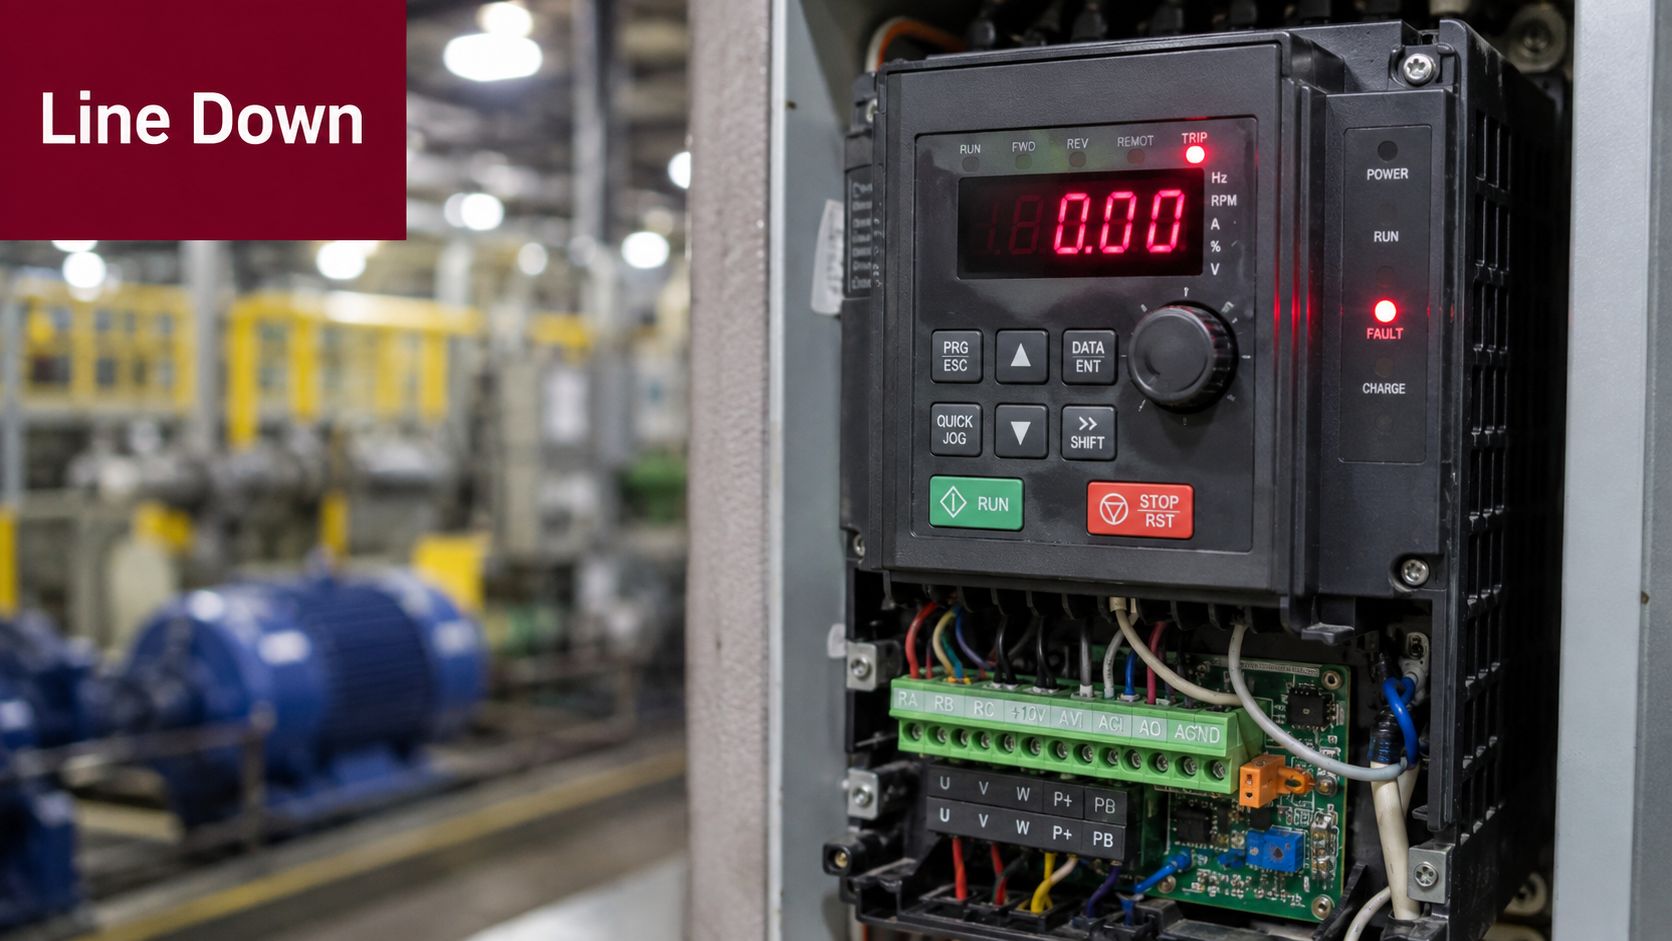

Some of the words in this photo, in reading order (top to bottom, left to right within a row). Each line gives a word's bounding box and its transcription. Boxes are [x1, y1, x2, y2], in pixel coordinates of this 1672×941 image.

[960, 144, 981, 155] RUN
[1012, 141, 1036, 152] FWD
[1067, 138, 1089, 150] REV
[1117, 135, 1154, 148] REMOT
[1182, 132, 1208, 145] TRIP
[1211, 171, 1228, 184] Hz
[1366, 167, 1409, 181] POWER
[1211, 195, 1237, 207] RPM
[1054, 190, 1185, 254] 0.00
[1211, 218, 1220, 230] A
[1373, 230, 1399, 243] RUN
[1210, 263, 1220, 276] V
[1366, 327, 1404, 340] FAULT
[943, 341, 969, 355] PRG
[1072, 341, 1105, 355] DATA
[943, 359, 968, 372] ESC
[1076, 360, 1101, 373] ENT
[1362, 383, 1406, 395] CHARGE
[937, 415, 973, 429] QUICK
[943, 432, 967, 445] JOG
[1070, 436, 1105, 450] SHIFT
[977, 497, 1009, 512] RUN
[1139, 495, 1179, 509] STOP
[1145, 514, 1175, 529] RST
[899, 691, 919, 708] RA
[934, 695, 955, 713] RB
[973, 701, 995, 718] RC
[939, 777, 951, 790] U
[979, 781, 989, 795] V
[1016, 787, 1031, 801] W
[1053, 791, 1073, 808] P+
[1094, 798, 1116, 815] PB
[939, 808, 951, 823] U
[978, 813, 989, 828] V
[1016, 819, 1031, 835] W
[1052, 825, 1073, 841] P+
[1092, 831, 1113, 848] PB
